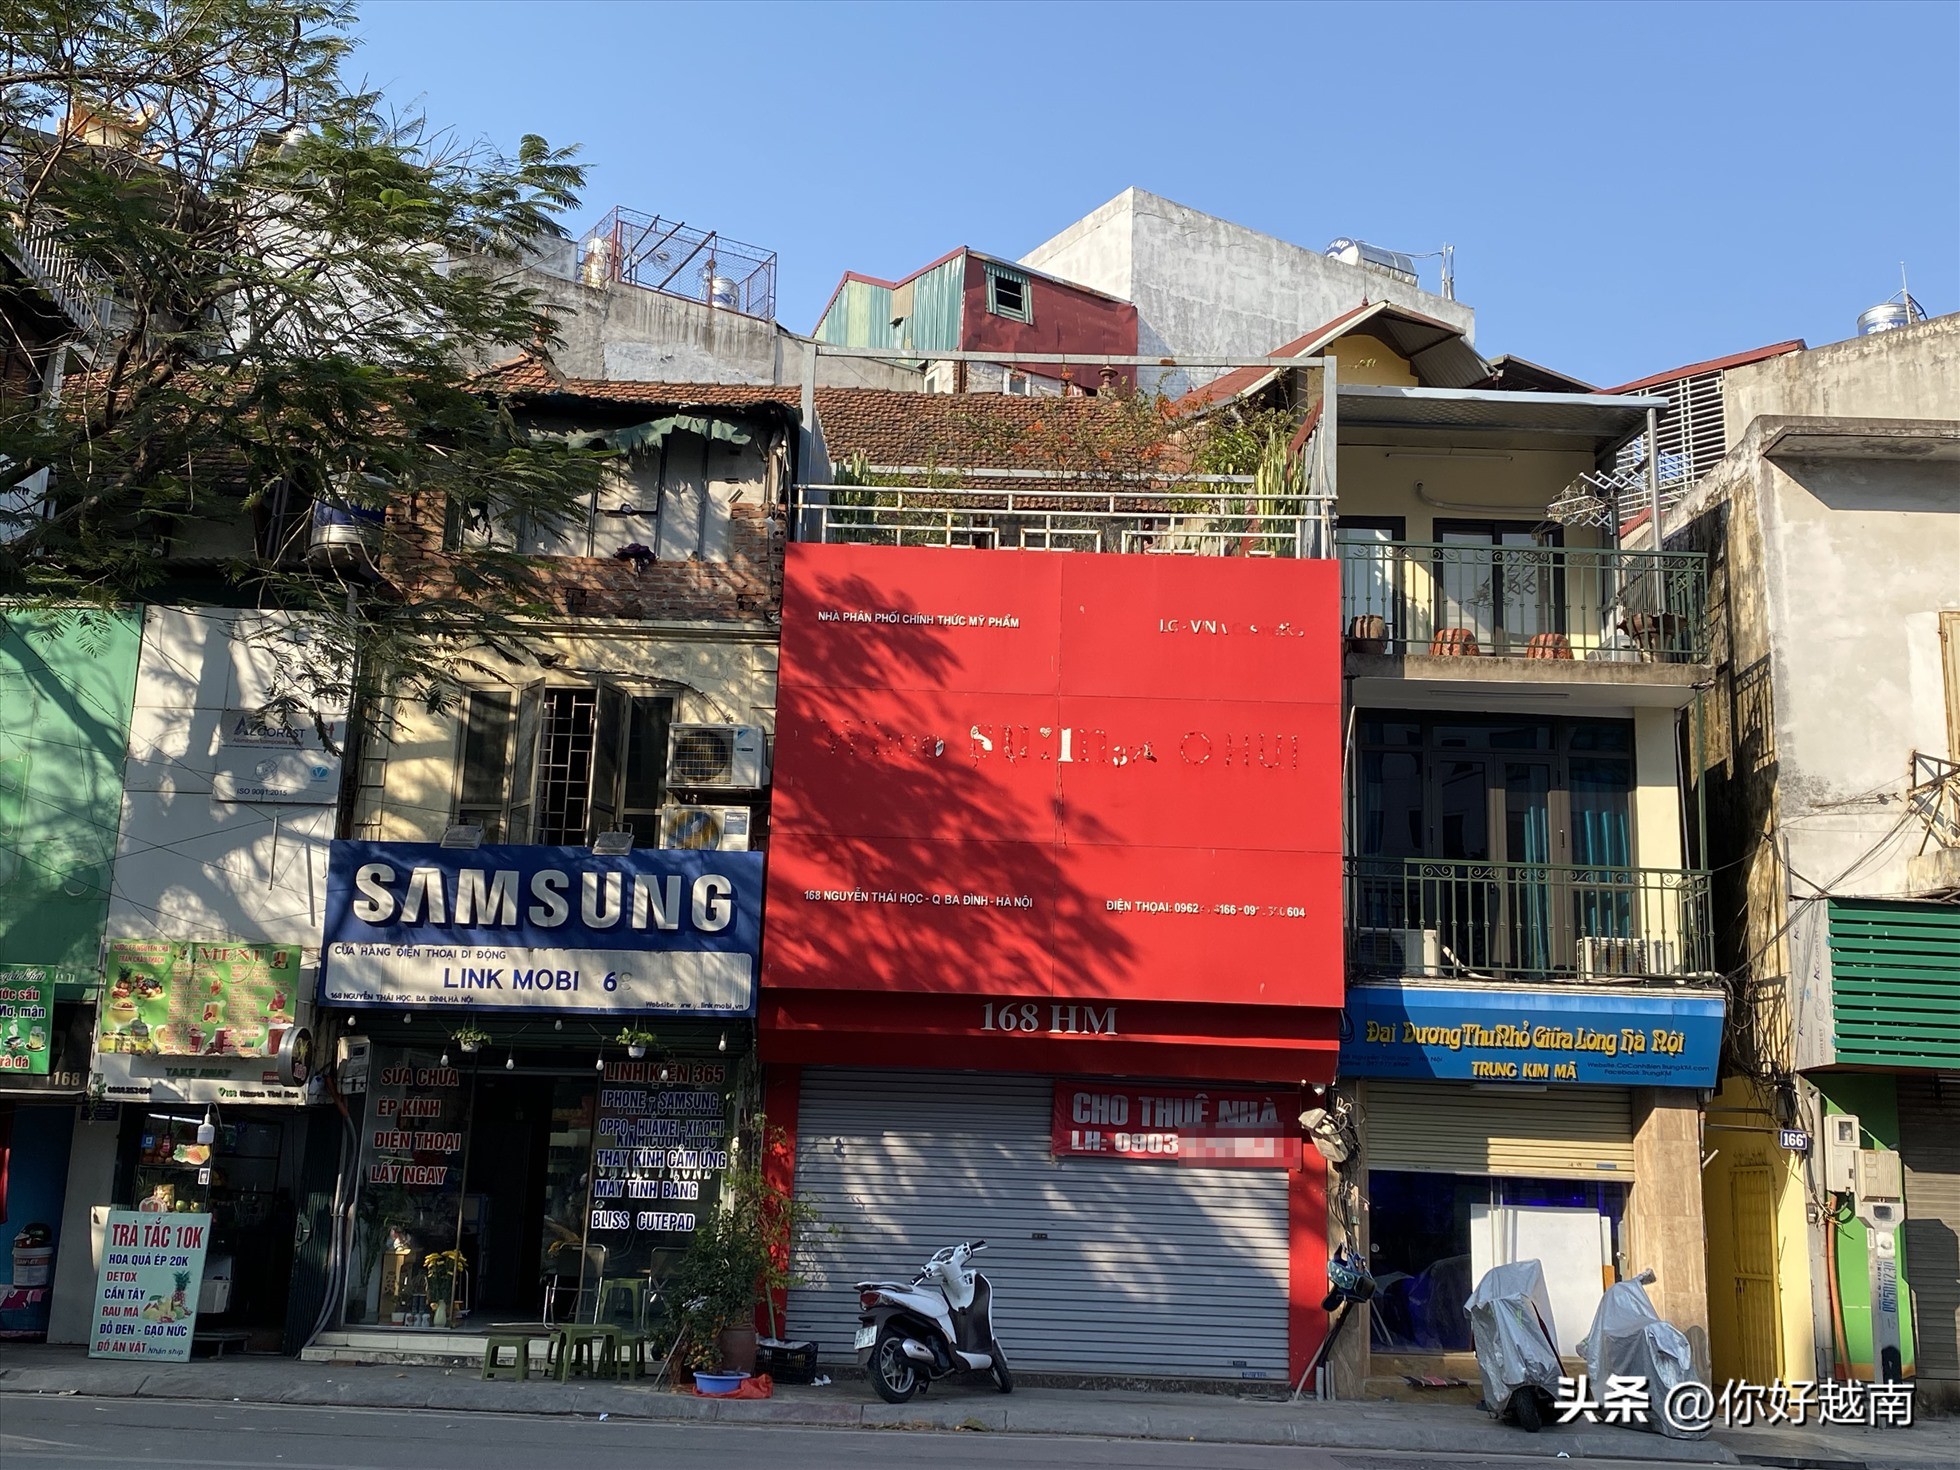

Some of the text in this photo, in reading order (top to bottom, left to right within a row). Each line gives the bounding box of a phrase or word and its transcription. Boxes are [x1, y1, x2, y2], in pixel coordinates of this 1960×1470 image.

[818, 611, 840, 622] NHÀ
[843, 611, 872, 623] PHÂN
[875, 611, 900, 624] PHỐI
[902, 613, 934, 625] CHÍNH
[937, 613, 966, 626] THỨC
[988, 613, 1019, 628] PHẨM
[353, 862, 733, 933] SAMSUNG
[804, 890, 821, 900] 168
[823, 887, 869, 902] NGUYỄN
[871, 890, 897, 902] THÁI
[900, 893, 923, 906] HỌC
[944, 895, 960, 905] BA
[963, 892, 988, 906] ĐÌNH
[996, 894, 1012, 907] HÀ
[1014, 896, 1033, 910] NỘI
[1105, 898, 1132, 914] ĐIỆN
[335, 945, 506, 961] CỬA HÀNG ĐIỆN THOẠI DI ĐỘNG
[444, 968, 504, 990] LINK
[513, 968, 579, 991] MOBI
[21, 1006, 46, 1021] mận
[979, 1002, 1119, 1036] 168 HM
[1366, 1020, 1396, 1047] Đại
[1402, 1022, 1461, 1050] Dương
[1462, 1024, 1496, 1047] Thu
[1574, 1027, 1619, 1056] Lòng
[1651, 1029, 1686, 1056] Nội
[53, 1072, 81, 1086] 168
[165, 1067, 232, 1077] TAKE AWAY
[381, 1063, 413, 1086] SỬA
[604, 1061, 645, 1082] LINH
[693, 1065, 725, 1085] 365
[1472, 1060, 1577, 1079] TRUNG KIM MÃ
[377, 1095, 441, 1118] ÉP KÍNH
[601, 1090, 647, 1108] IPHONE
[658, 1092, 720, 1110] SAMSUNG
[1072, 1092, 1278, 1128] CHO THUÊ NHÀ
[600, 1118, 629, 1136] OPPO
[637, 1119, 680, 1137] HUAWEI
[685, 1120, 725, 1138] XIAOMI
[373, 1128, 461, 1155] ĐIỆN THOẠI
[1071, 1131, 1108, 1151] LH:
[1114, 1132, 1179, 1155] 0903
[1782, 1132, 1804, 1147] 166
[596, 1144, 727, 1169] THAY KÍNH CẢM ỨNG
[370, 1159, 448, 1185] LẤY NGAY
[594, 1175, 699, 1200] MÁY TÍNH BẢNG
[591, 1210, 696, 1232] BLISS CUTEPAD
[112, 1217, 204, 1249] TRÀ TẮC 10K
[109, 1252, 189, 1267] HOA QUẢ ÉP 20K
[106, 1271, 138, 1282] DETOX
[127, 1287, 146, 1300] TÂY
[102, 1305, 139, 1317] RAU MÁ
[115, 1324, 135, 1335] ĐEN
[144, 1325, 164, 1338] GẠO
[112, 1340, 126, 1353] ĂN
